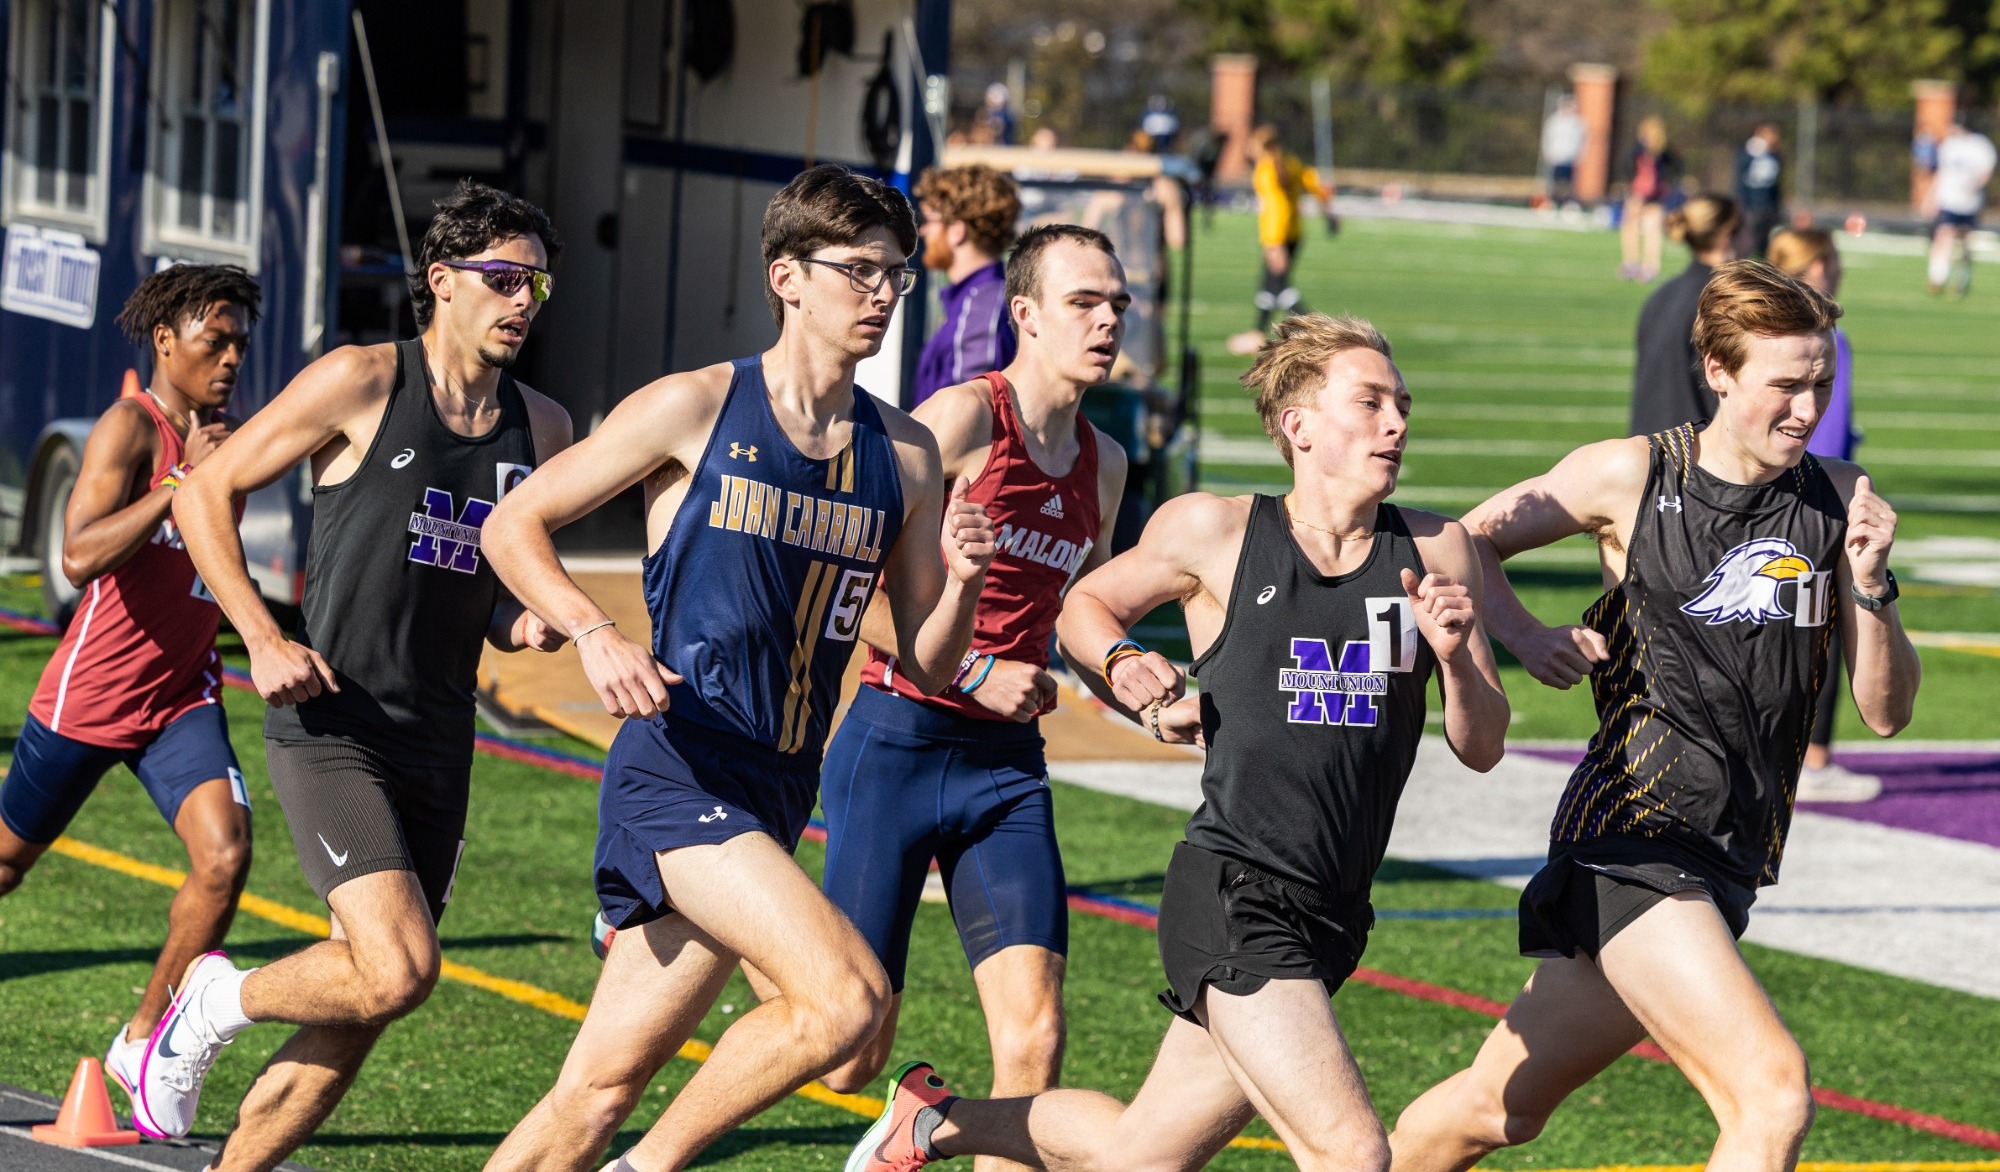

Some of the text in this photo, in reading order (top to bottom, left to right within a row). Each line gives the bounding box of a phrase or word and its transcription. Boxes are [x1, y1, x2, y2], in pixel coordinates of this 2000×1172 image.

[453, 522, 482, 544] UNIO
[709, 474, 885, 563] JOHN CARROLL
[1040, 506, 1064, 519] adidas
[995, 523, 1083, 575] MALON
[834, 576, 871, 636] 5
[1376, 603, 1401, 667] 1
[1282, 671, 1386, 692] MOUNT UNION
